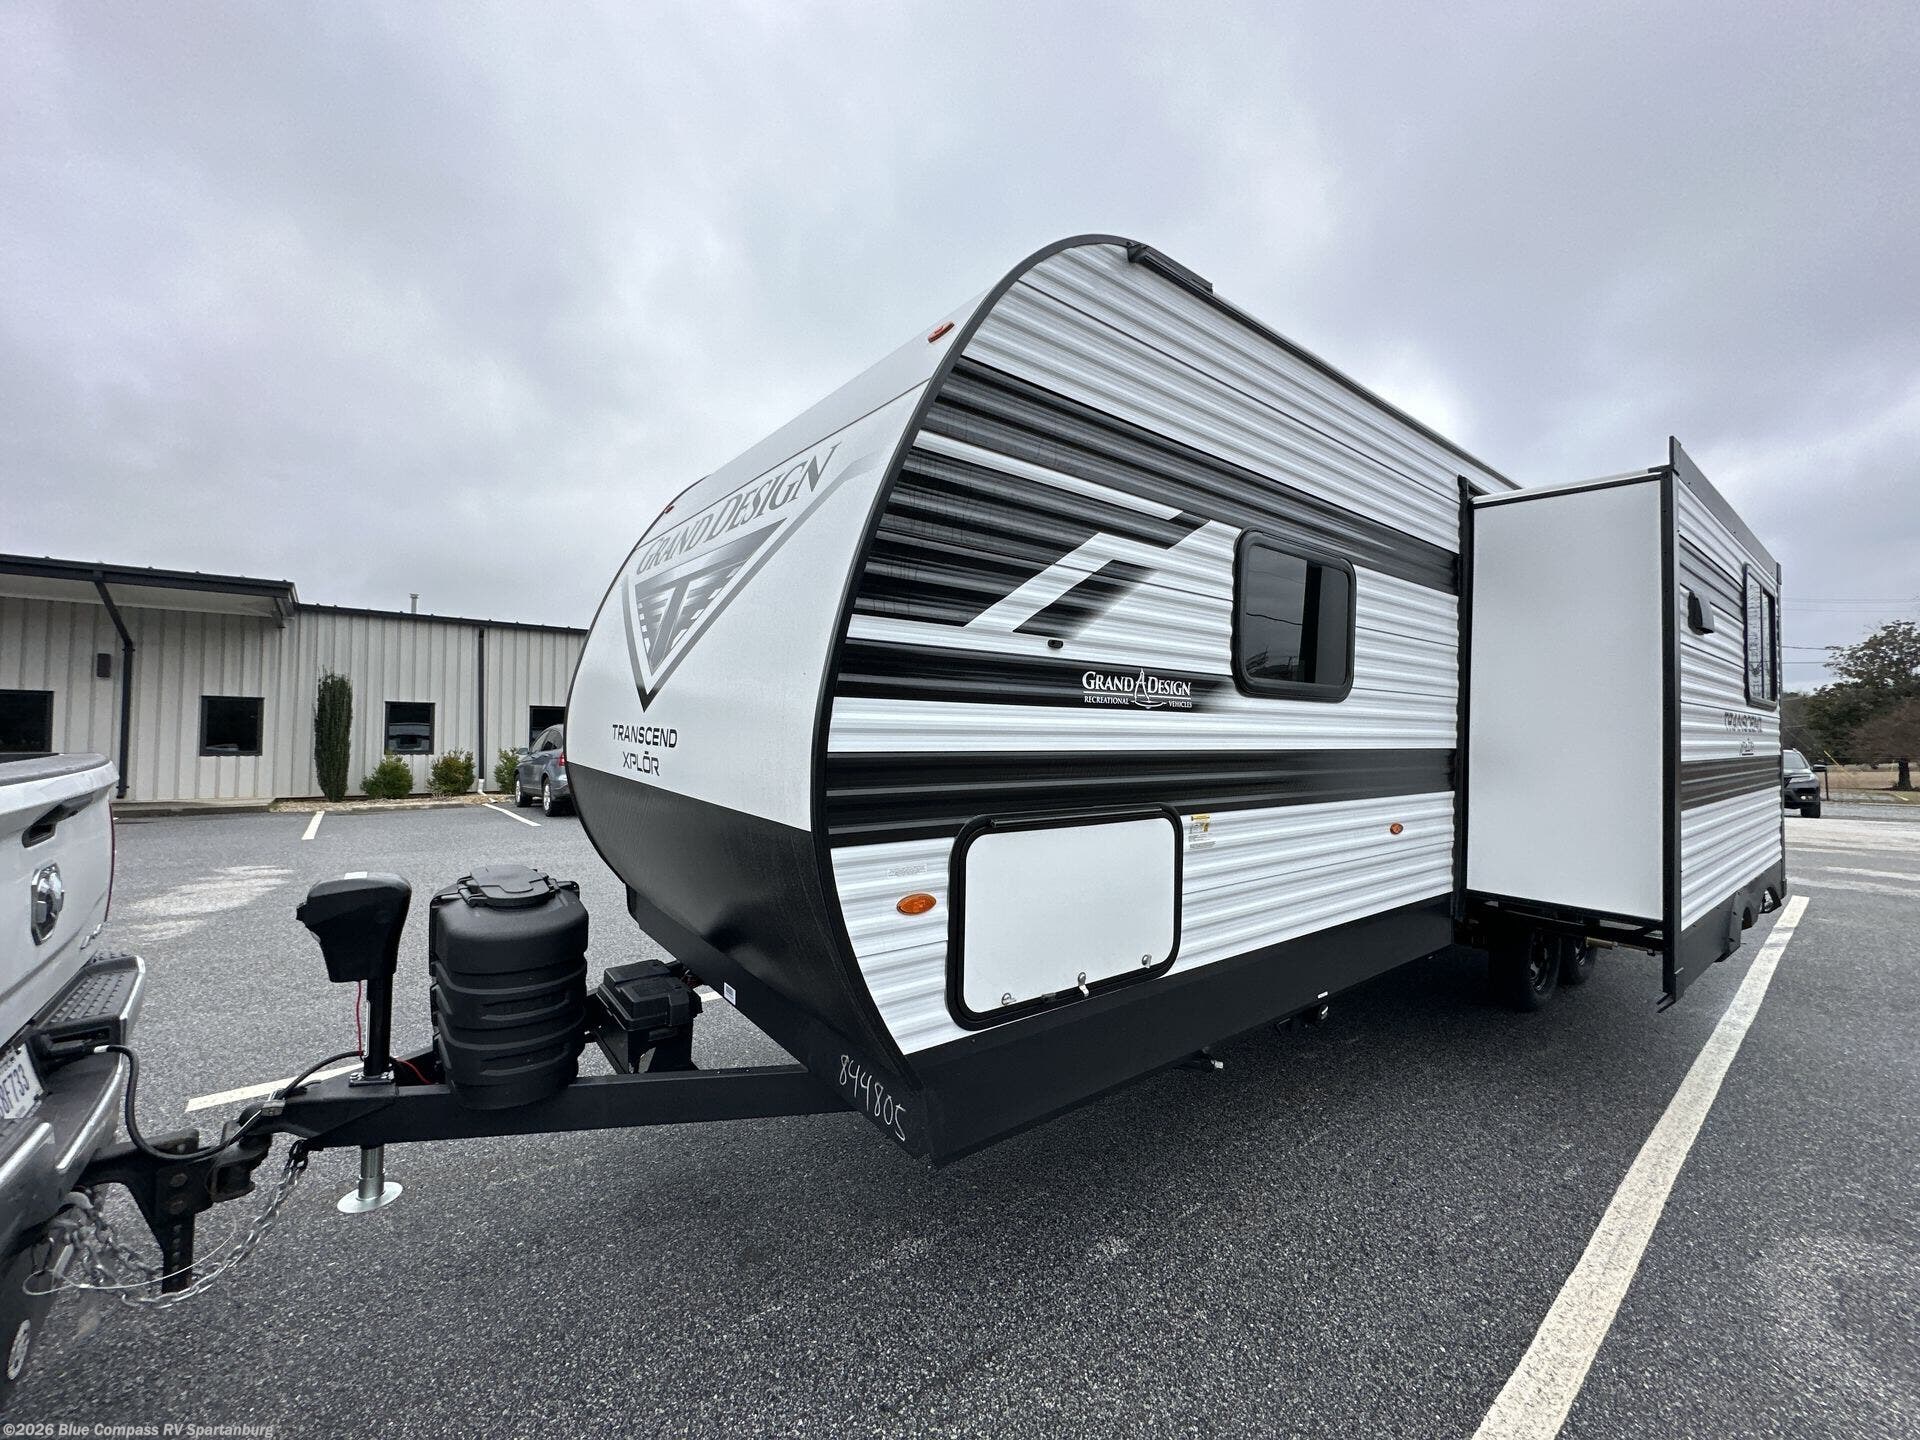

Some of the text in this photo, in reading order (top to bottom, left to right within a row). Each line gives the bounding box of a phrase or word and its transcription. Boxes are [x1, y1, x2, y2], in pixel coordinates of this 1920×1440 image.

[636, 441, 842, 575] GRAND DESIGN
[1082, 671, 1191, 696] GRAND DESIGN
[1084, 695, 1192, 708] RECREATIONAL VEHICLES
[612, 724, 678, 748] TRANSCEND
[839, 1054, 906, 1141] 844805
